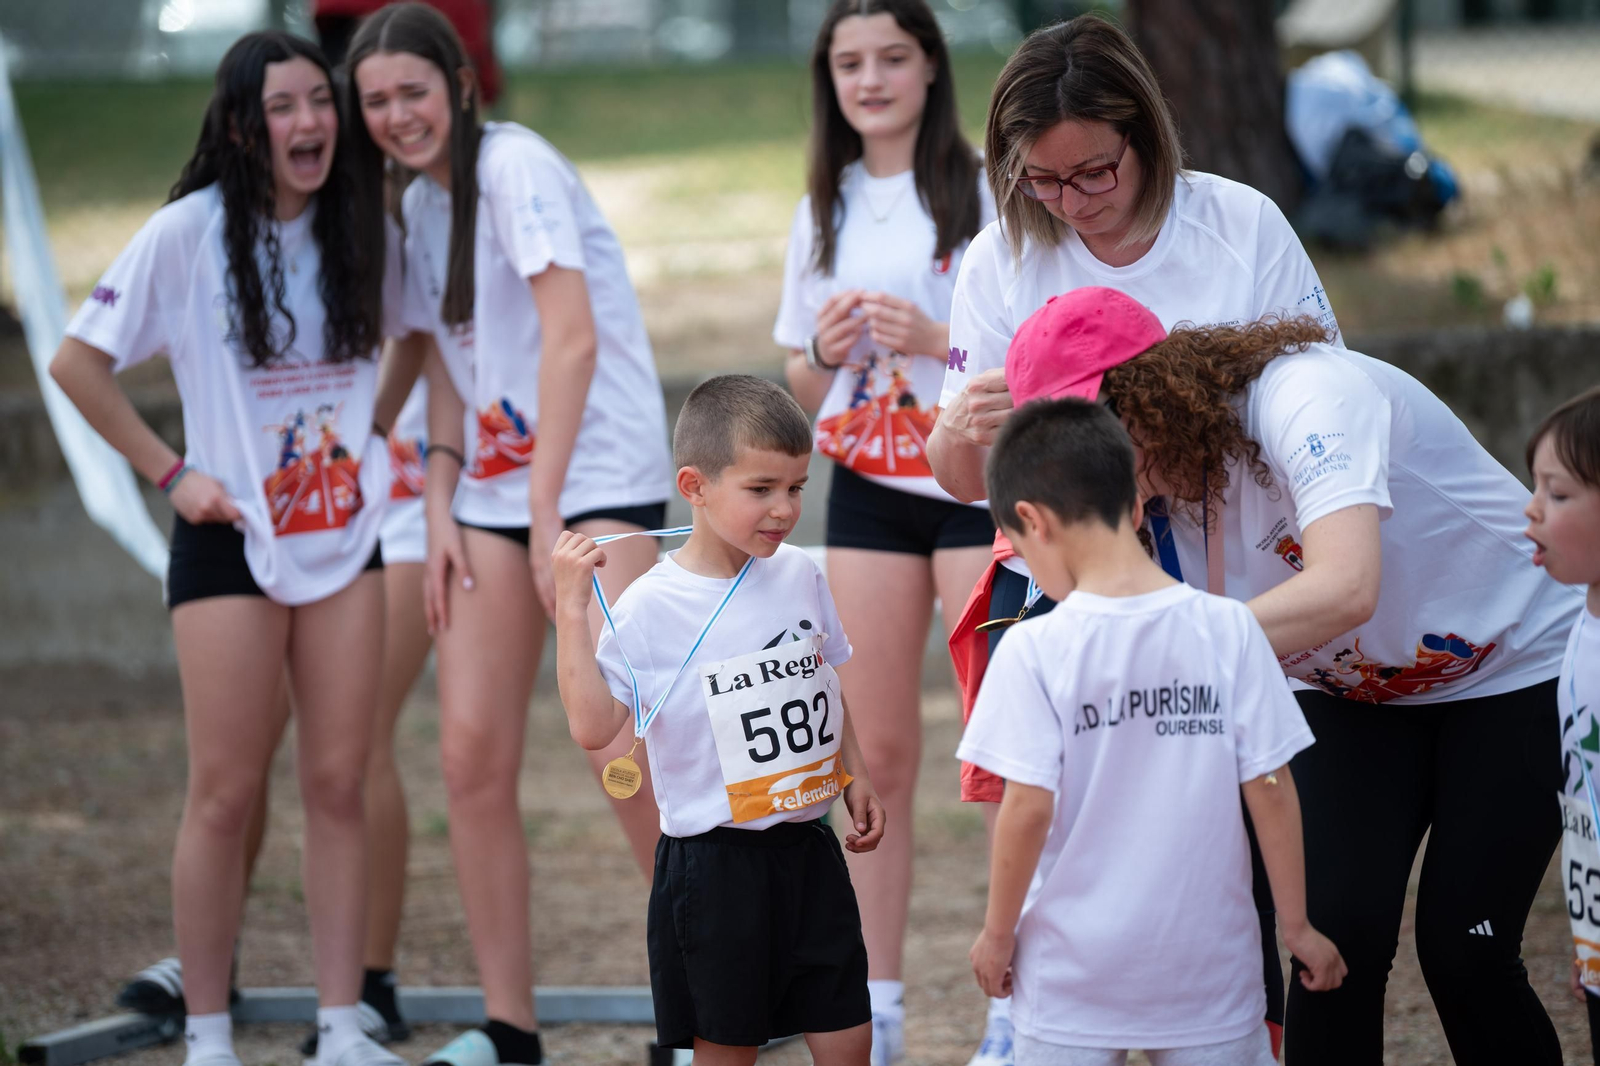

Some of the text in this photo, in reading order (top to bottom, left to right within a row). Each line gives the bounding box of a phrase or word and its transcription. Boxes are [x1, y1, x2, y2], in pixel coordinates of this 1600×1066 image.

[1301, 462, 1350, 486] OURENSE
[705, 672, 754, 697] La
[1129, 679, 1223, 719] PURÍSIMA
[740, 690, 834, 763] 582
[1156, 718, 1225, 736] OURENSE
